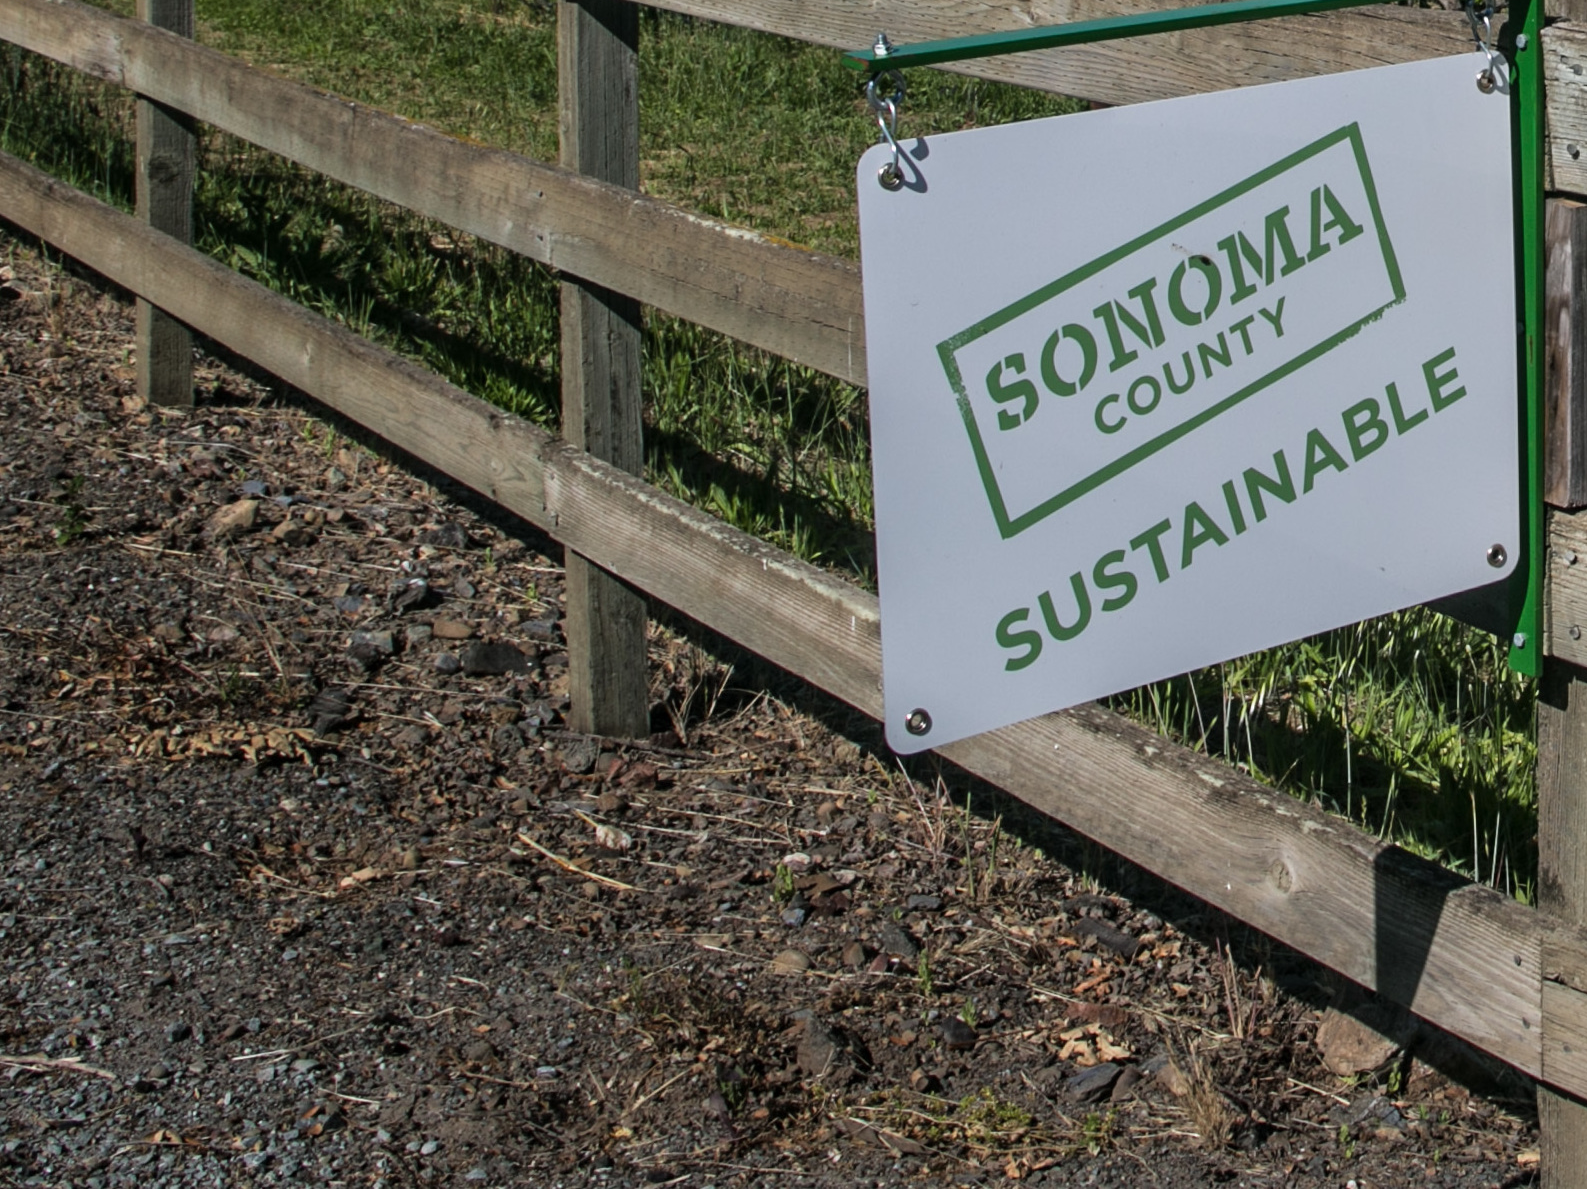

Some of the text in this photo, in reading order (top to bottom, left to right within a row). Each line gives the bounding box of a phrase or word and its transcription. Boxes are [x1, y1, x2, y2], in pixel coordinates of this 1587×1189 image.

[986, 183, 1364, 431] SONOMA
[1094, 296, 1286, 434] COUNTY
[995, 346, 1467, 672] SUSTAINABLE
